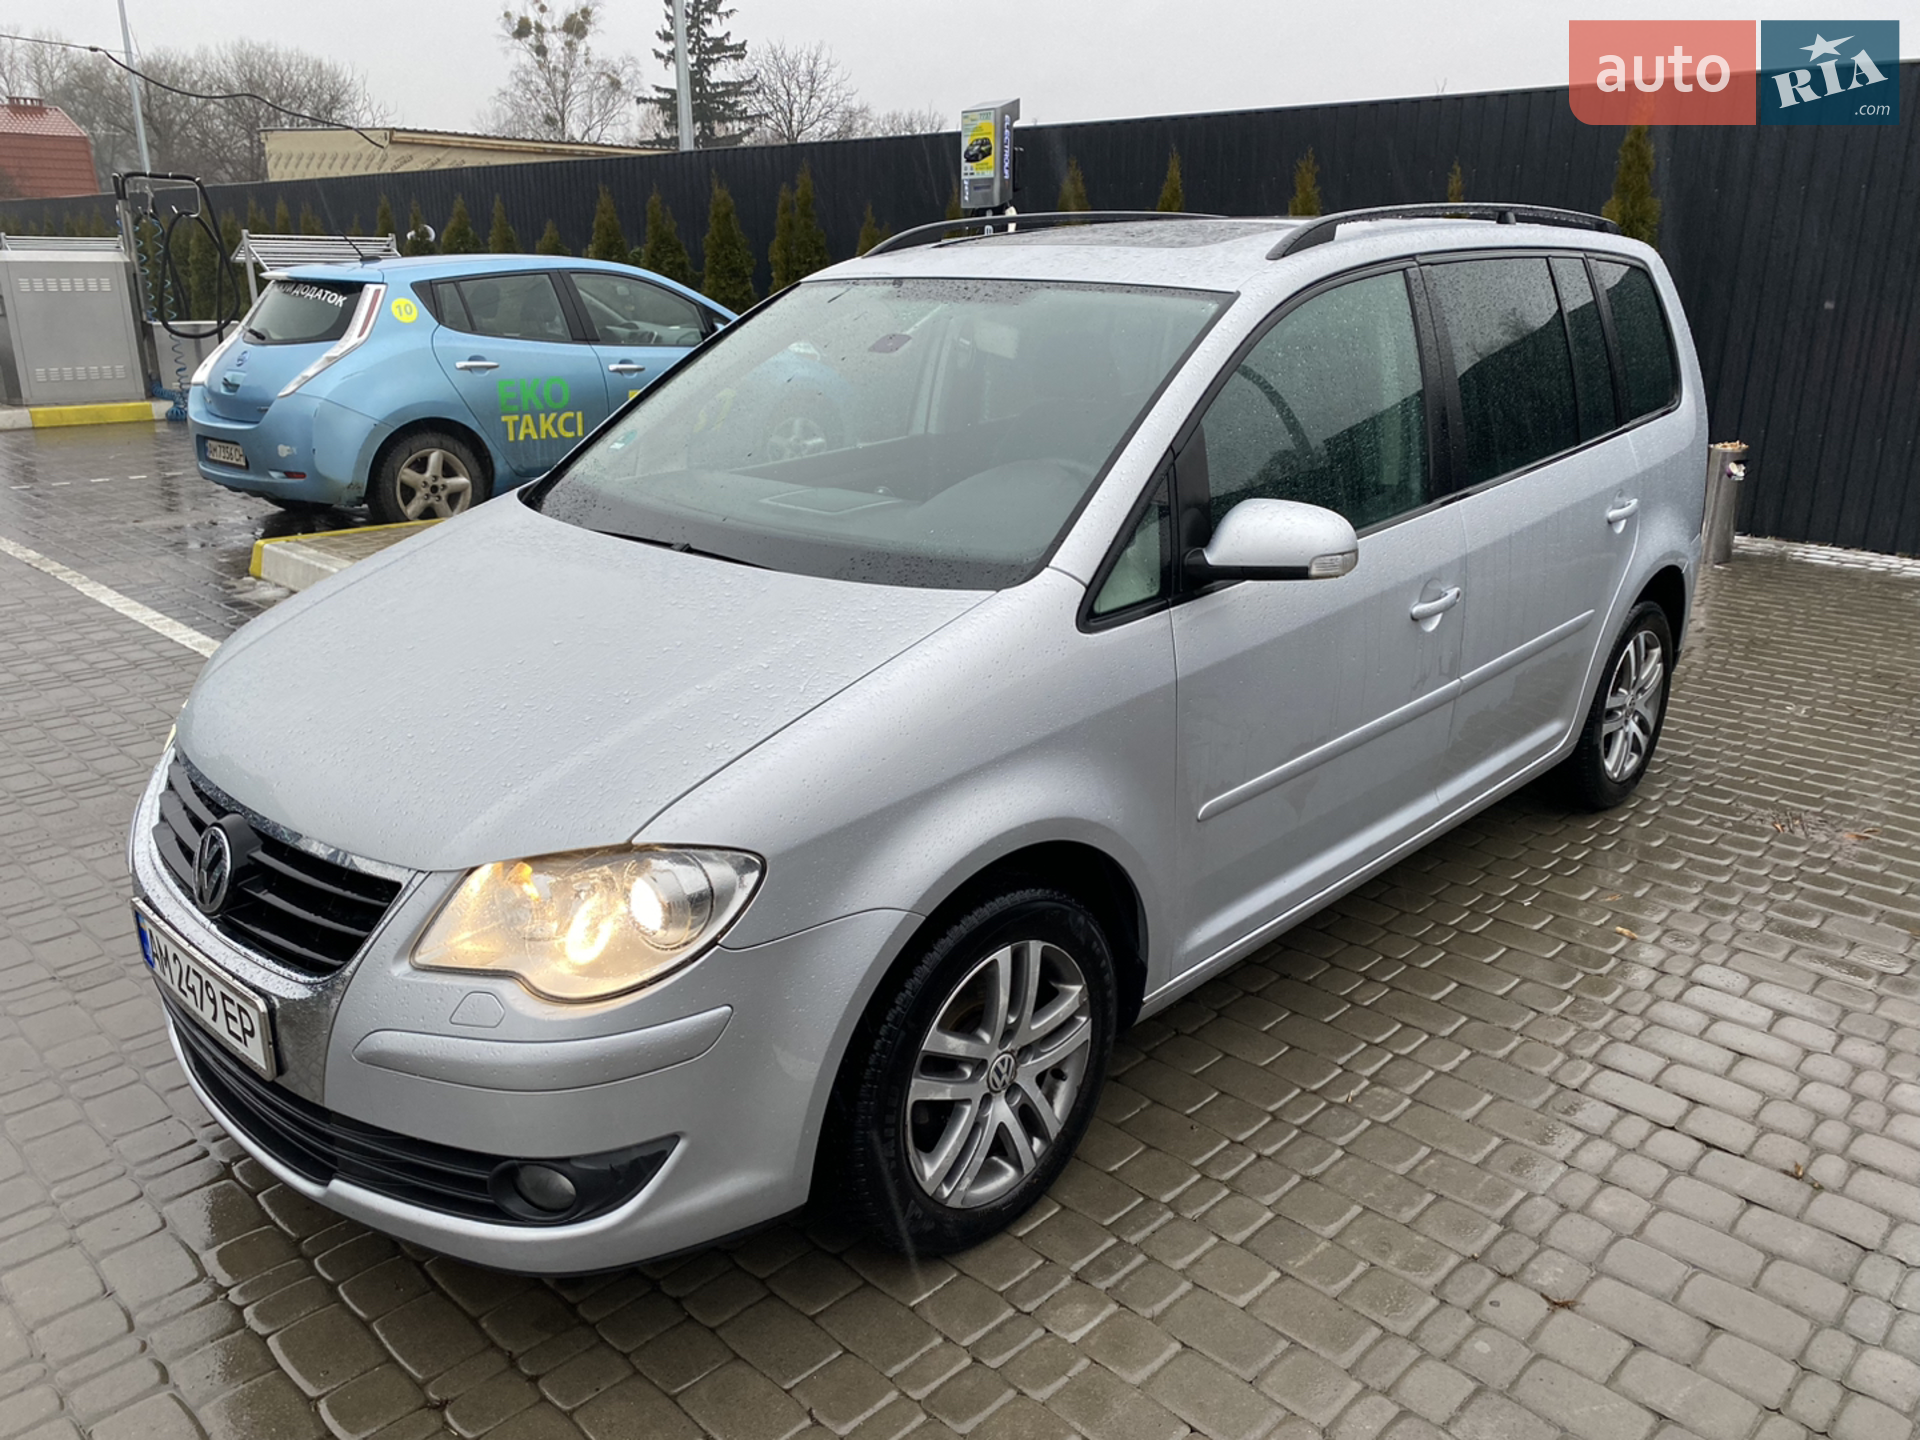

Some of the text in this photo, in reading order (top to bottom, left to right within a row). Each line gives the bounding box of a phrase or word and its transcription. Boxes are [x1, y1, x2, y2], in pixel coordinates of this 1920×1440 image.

[291, 283, 348, 308] ДОДАТОК
[395, 303, 413, 317] 10
[172, 952, 218, 1023] 2479
[220, 990, 256, 1048] EP
